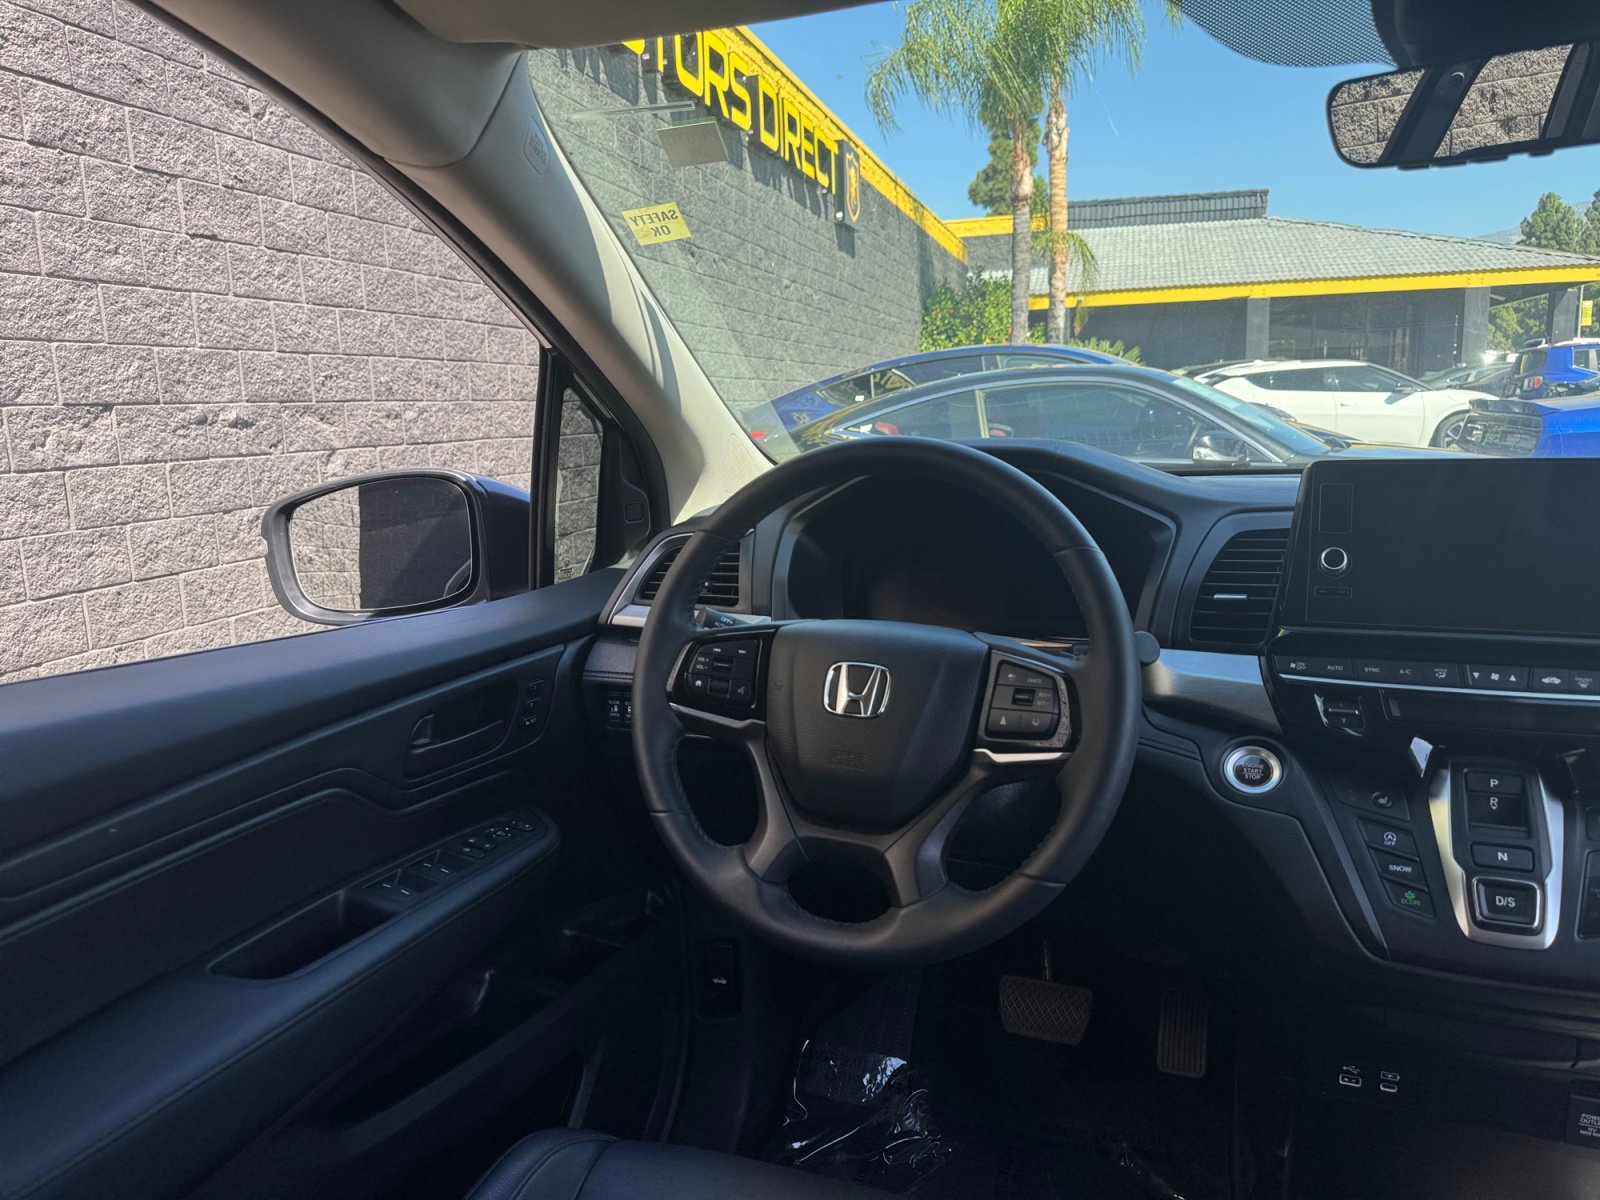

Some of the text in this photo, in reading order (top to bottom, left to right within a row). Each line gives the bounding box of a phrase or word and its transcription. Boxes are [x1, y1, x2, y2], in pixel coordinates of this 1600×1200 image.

[757, 76, 839, 195] DIRECT
[1489, 778, 1499, 788] P
[1489, 797, 1498, 807] R
[1497, 852, 1508, 862] N
[1388, 864, 1412, 873] SNOW
[1400, 898, 1421, 906] ECON
[1495, 895, 1516, 908] D/S
